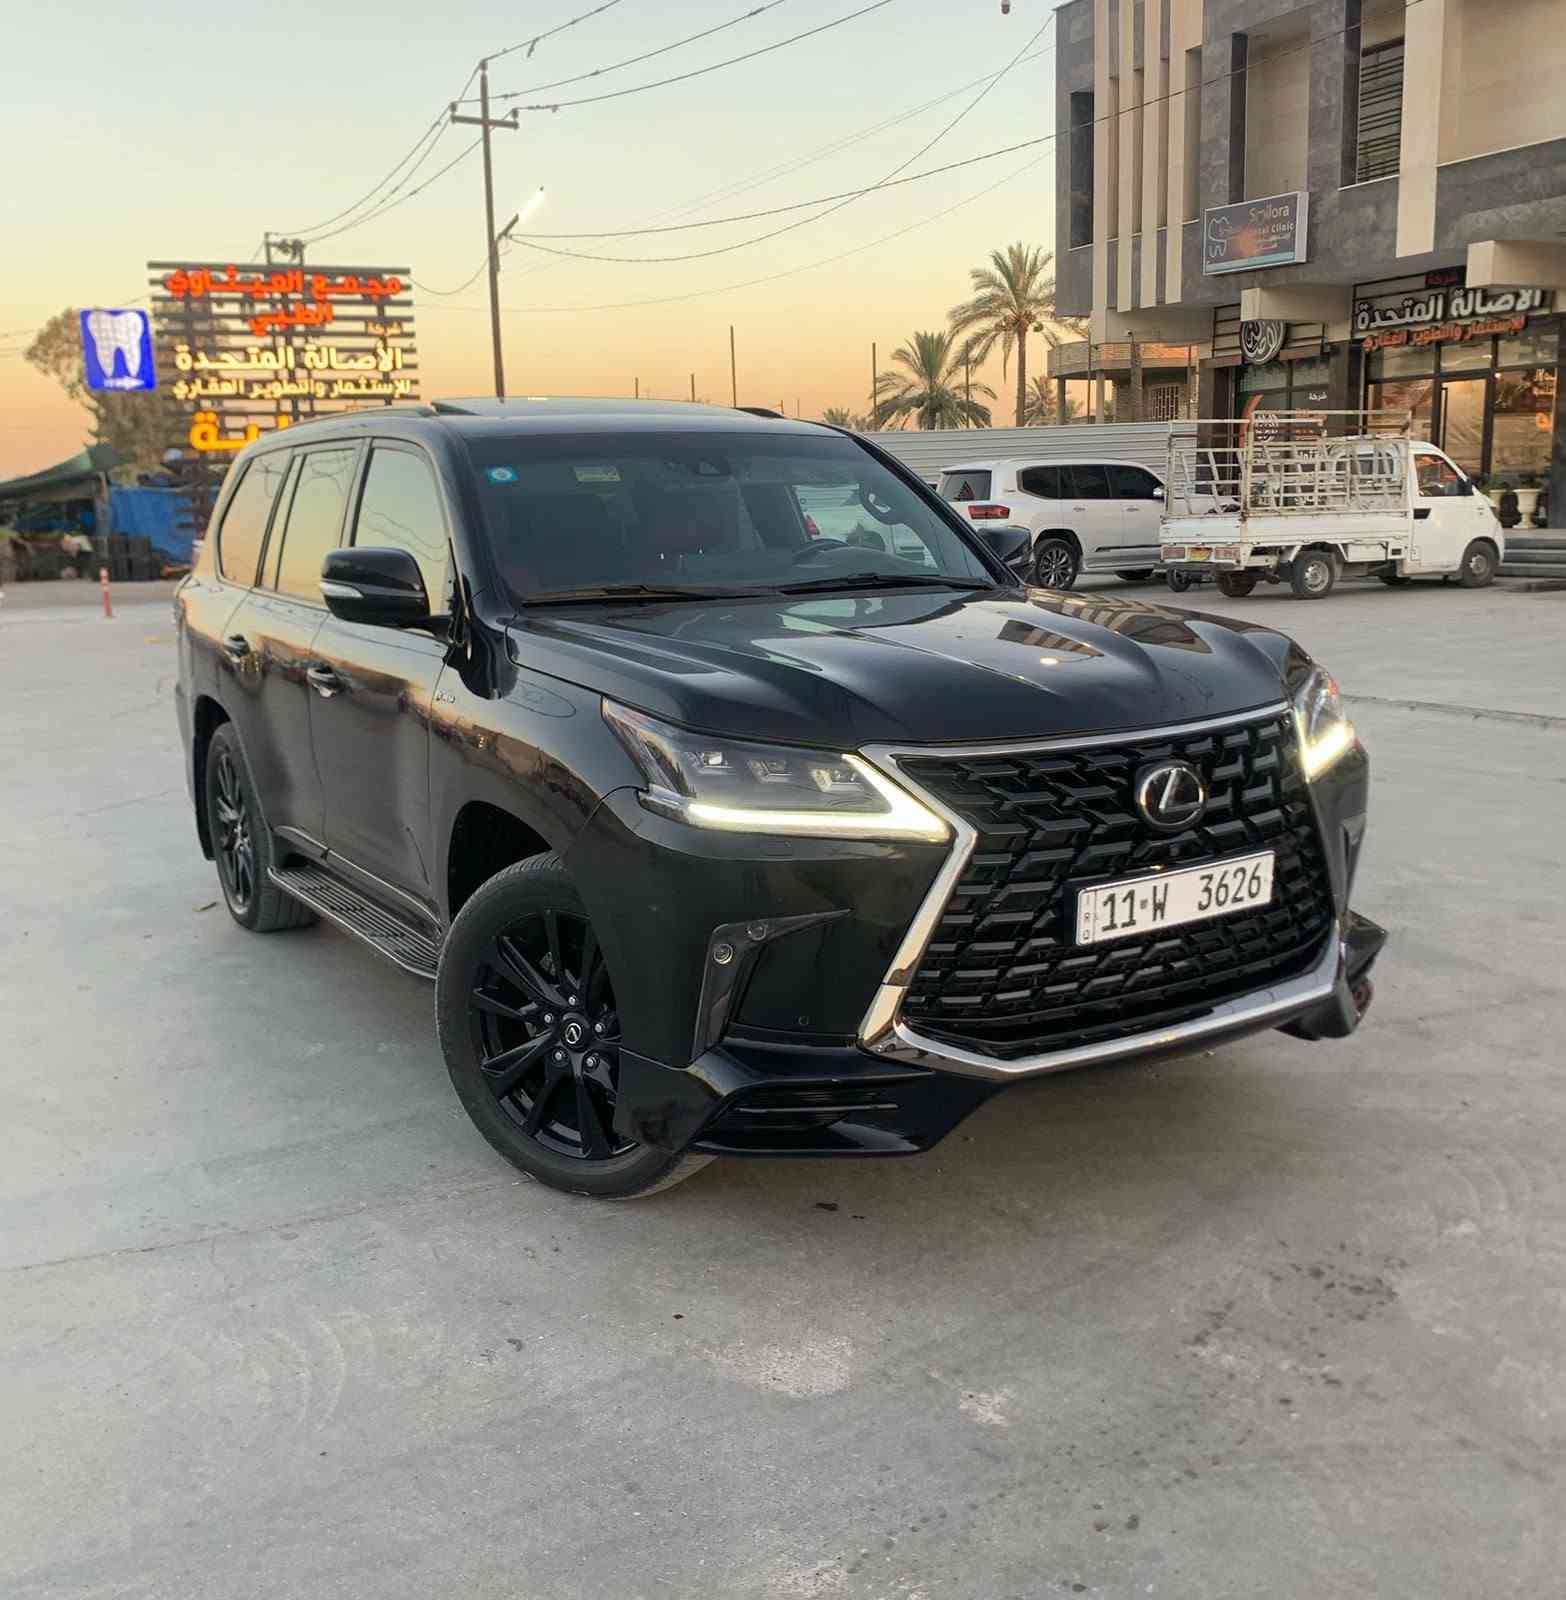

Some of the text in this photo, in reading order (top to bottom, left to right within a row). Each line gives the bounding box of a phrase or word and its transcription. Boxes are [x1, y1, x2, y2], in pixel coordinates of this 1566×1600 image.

[311, 273, 402, 304] مجمع
[248, 302, 334, 337] الطبي
[1357, 295, 1444, 330] المتحدة
[175, 344, 295, 371] المتحدة
[1101, 862, 1262, 932] 11 W 3626
